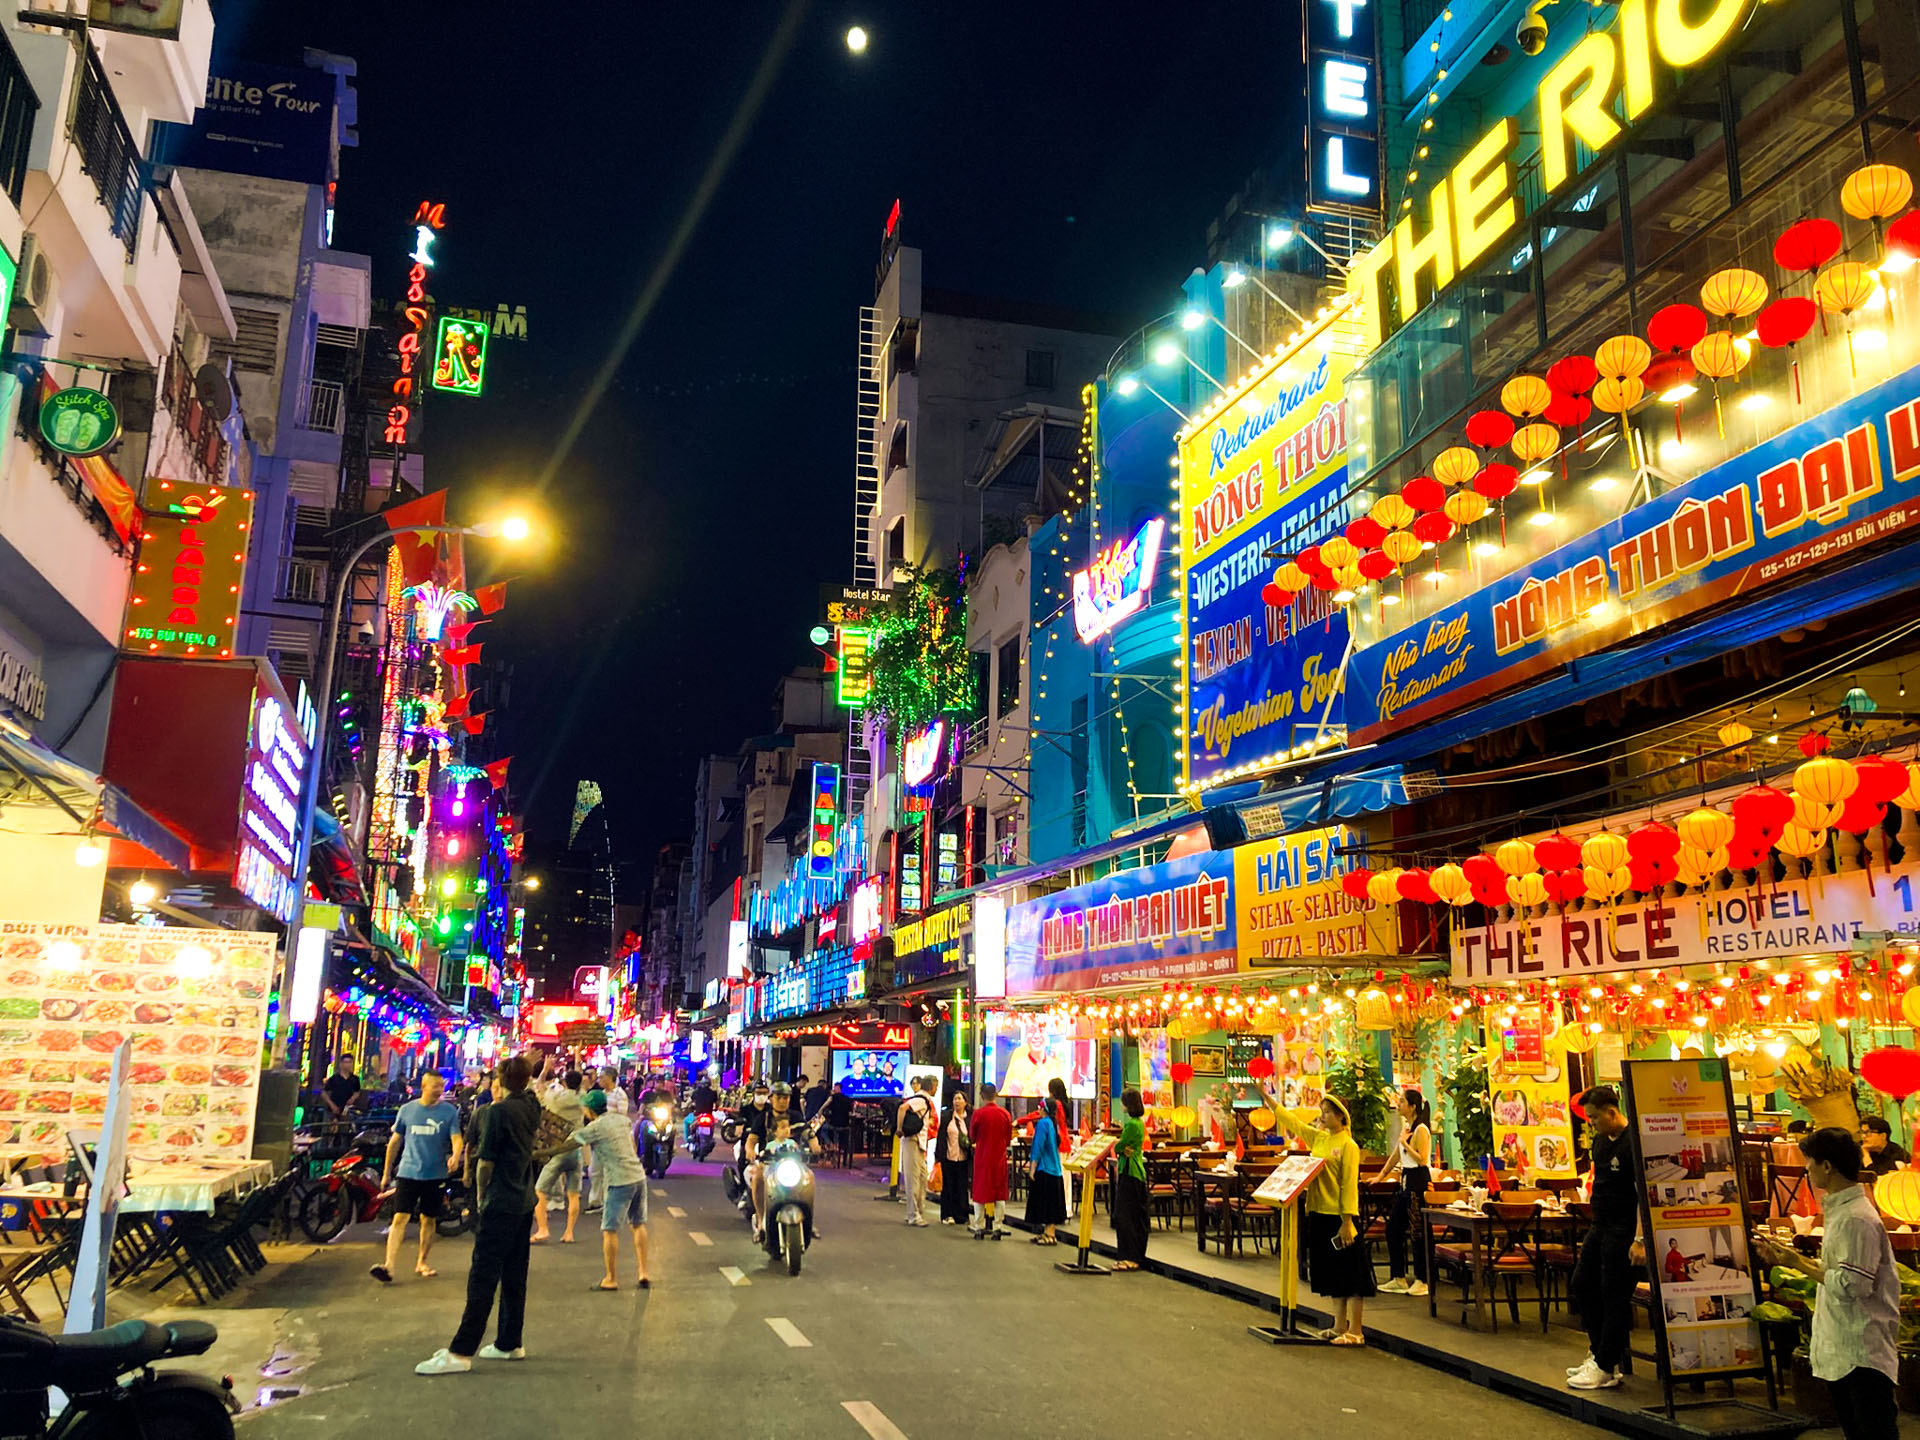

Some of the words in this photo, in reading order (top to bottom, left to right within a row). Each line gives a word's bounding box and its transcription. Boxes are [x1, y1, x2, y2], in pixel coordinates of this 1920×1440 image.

[267, 81, 321, 114] Tour
[1347, 118, 1518, 353] THE
[1539, 0, 1748, 193] RIC
[56, 394, 93, 409] Stitch
[93, 400, 110, 420] Spa
[1210, 354, 1330, 476] Restaurant
[1193, 461, 1264, 549] NÔNG
[1089, 539, 1141, 601] Tiger
[1492, 555, 1609, 656] NÔNG
[1608, 482, 1755, 601] THÔN
[1755, 422, 1884, 540] ĐẠI
[1760, 532, 1853, 579] 125-127-129-131
[843, 588, 869, 600] Hostel
[871, 590, 892, 602] Star
[1196, 532, 1271, 611] WESTERN
[1194, 614, 1252, 683] MEXICAN
[1382, 640, 1420, 689] Nhà
[1422, 612, 1470, 657] hàng
[16, 664, 48, 721] HOTEL
[1376, 643, 1475, 722] Restaurant
[1198, 690, 1294, 757] Vegetarian
[1256, 838, 1301, 895] HẢI
[1043, 908, 1085, 960] NÔNG
[1085, 892, 1135, 952] THÔN
[1133, 889, 1174, 949] ĐẠI
[1174, 871, 1229, 941] VIỆT
[1250, 899, 1295, 932] STEAK
[1304, 889, 1378, 923] SEAFOOD
[1706, 889, 1810, 927] HOTEL
[1707, 920, 1864, 955] RESTAURANT
[1262, 935, 1302, 958] PIZZA
[1317, 924, 1369, 957] PASTA
[1459, 926, 1544, 977] THE
[1562, 907, 1680, 968] RICE
